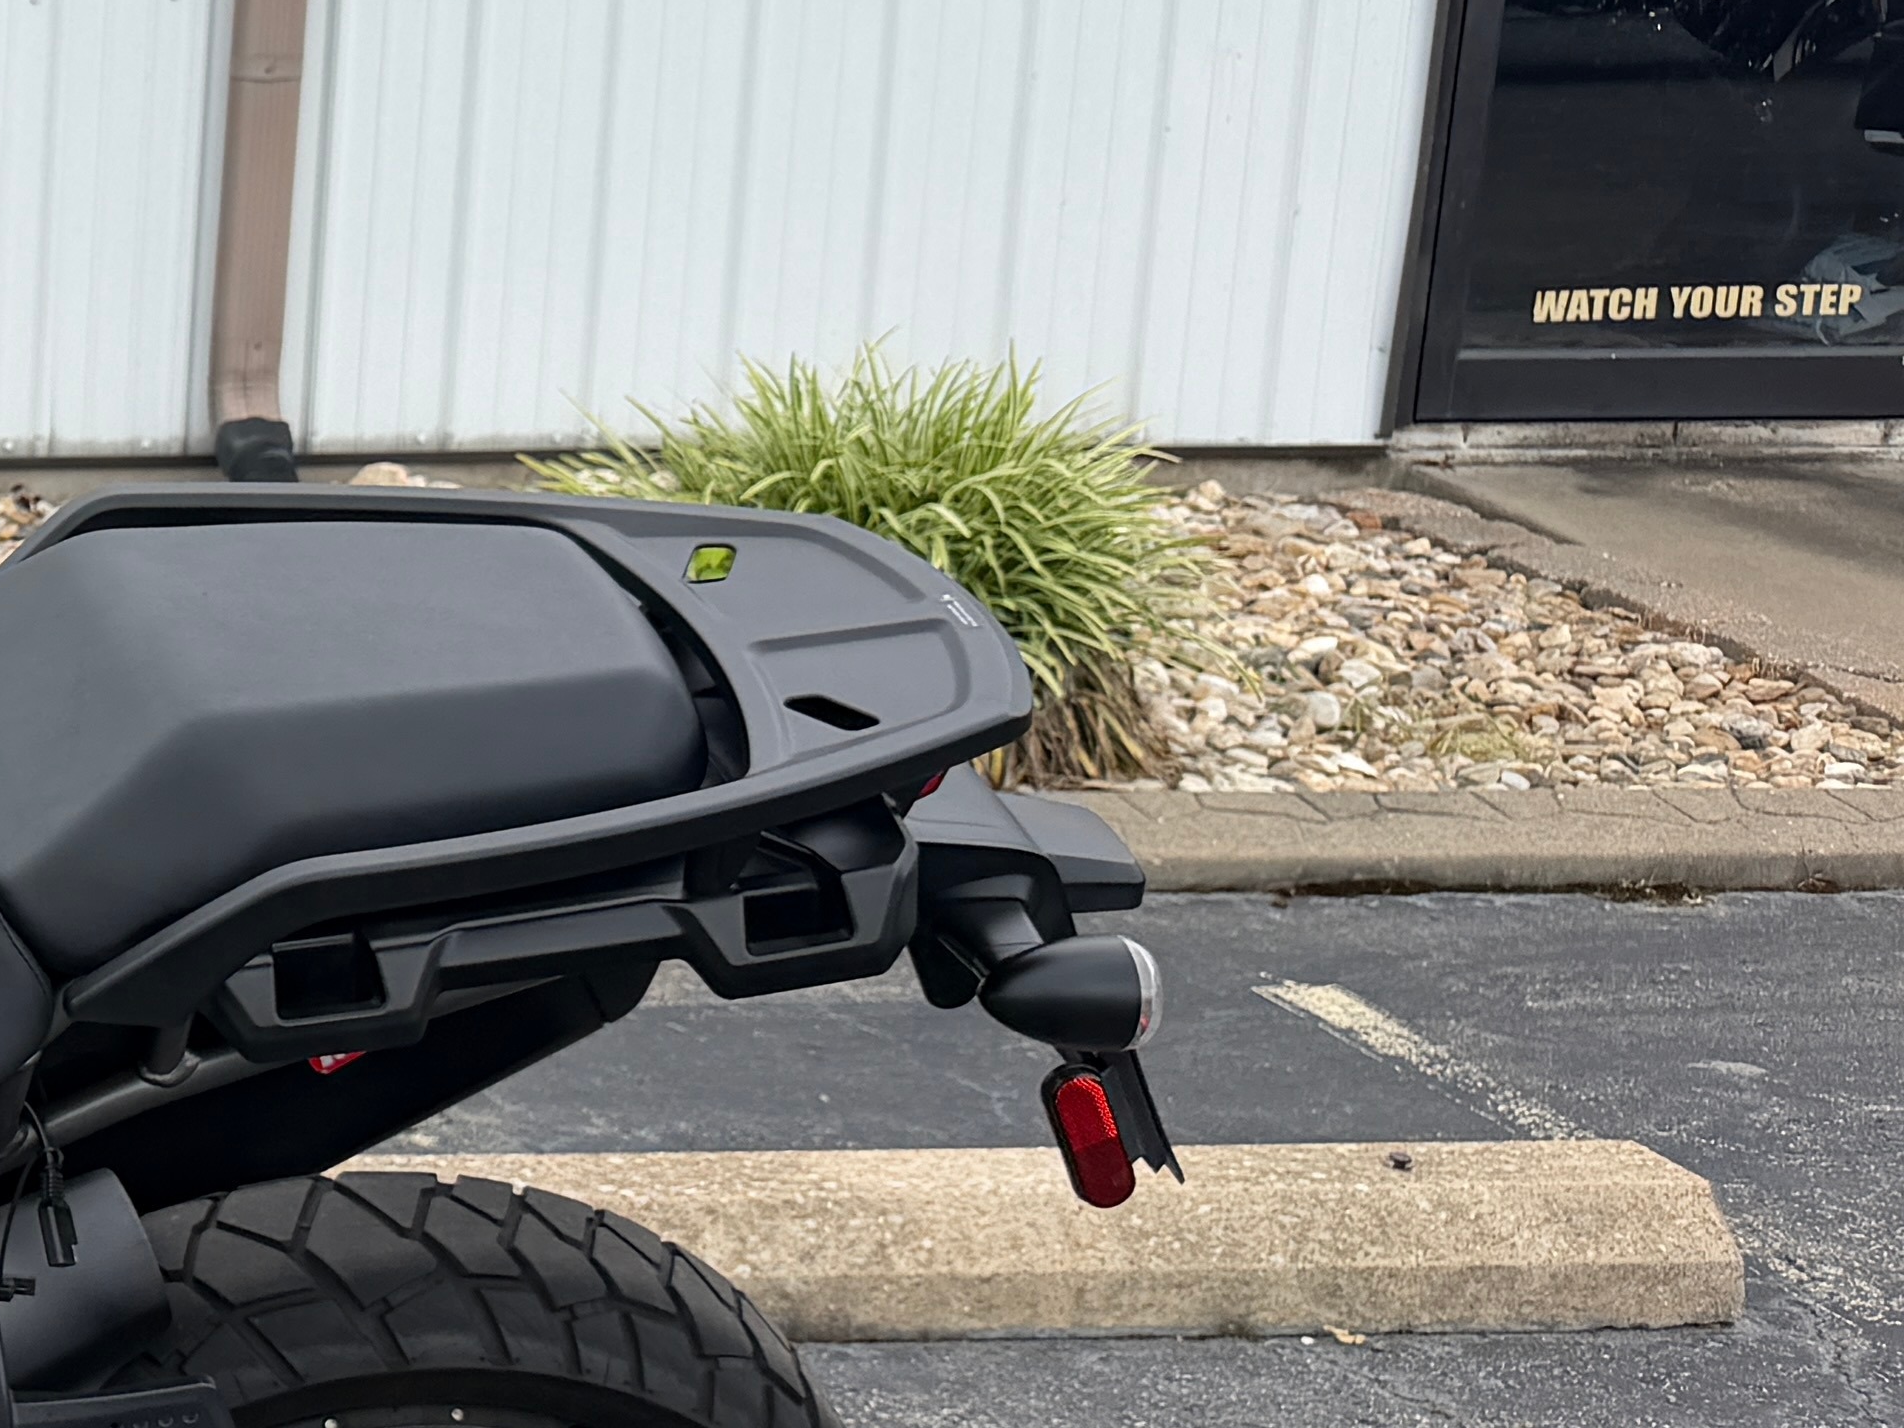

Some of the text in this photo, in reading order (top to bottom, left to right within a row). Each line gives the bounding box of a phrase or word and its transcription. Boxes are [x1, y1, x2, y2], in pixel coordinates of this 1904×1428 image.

[1533, 283, 1862, 323] WATCH YOUR STEP
